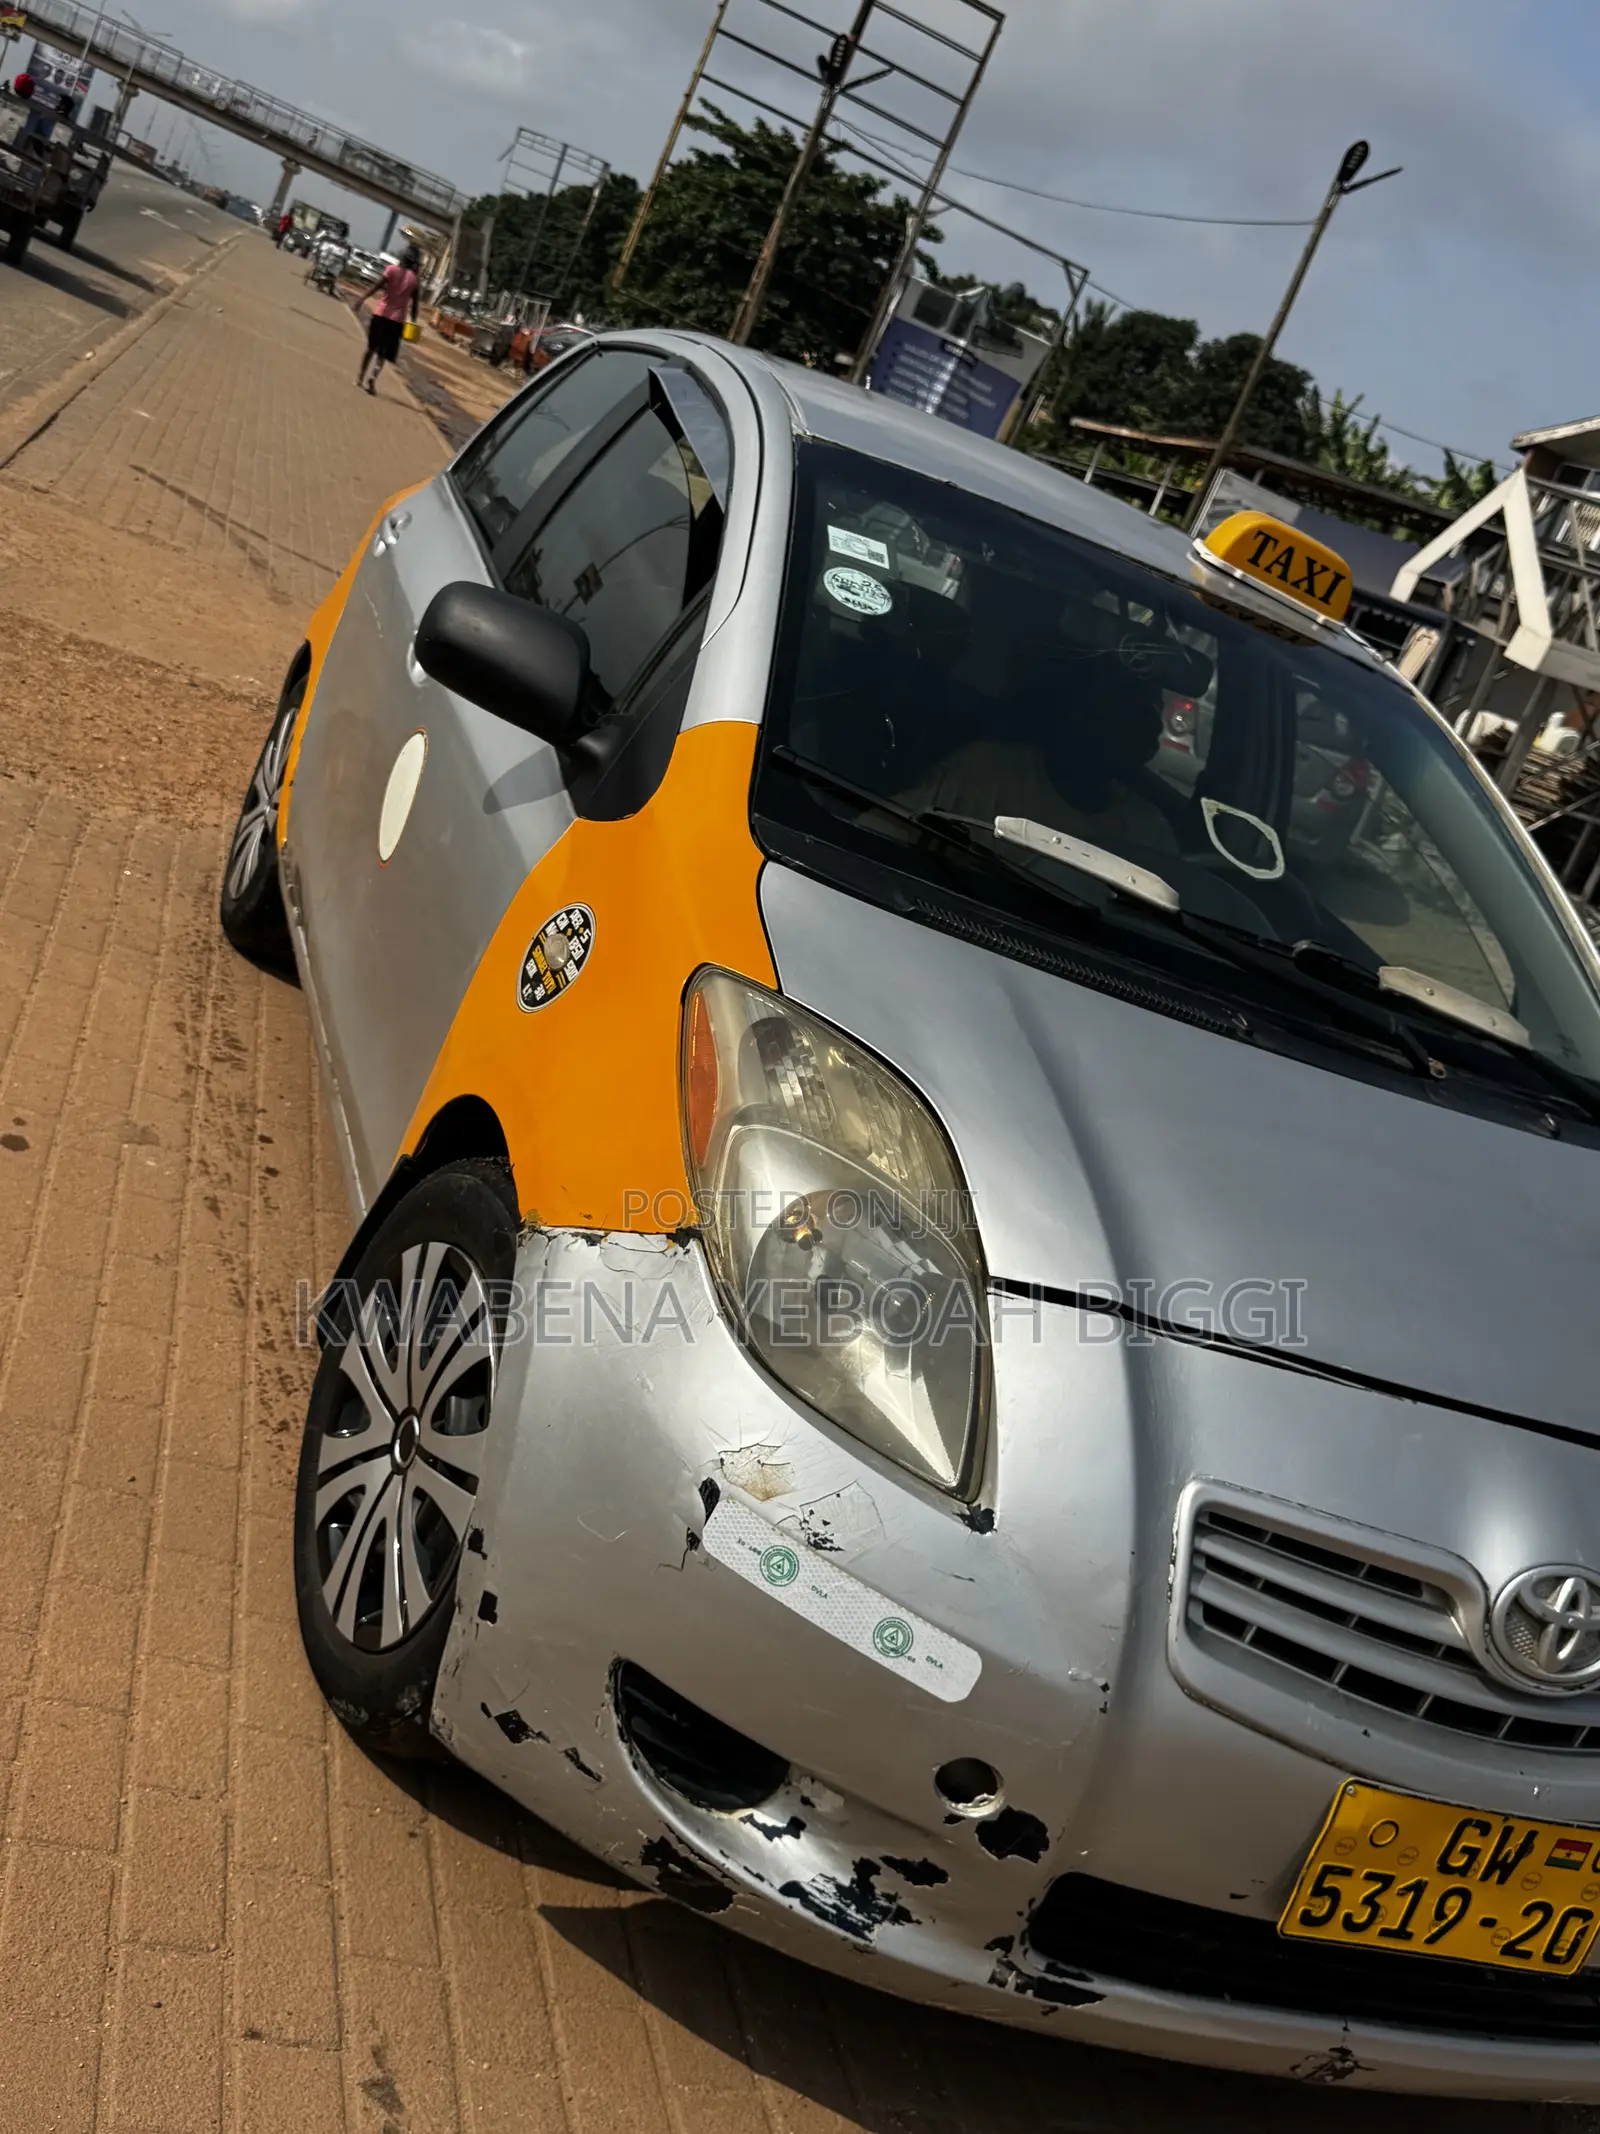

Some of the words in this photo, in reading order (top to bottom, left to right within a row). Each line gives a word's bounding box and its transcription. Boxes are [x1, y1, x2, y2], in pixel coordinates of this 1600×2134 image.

[1247, 530, 1346, 605] TAXI
[1436, 1817, 1539, 1885] GW
[1298, 1862, 1595, 1964] 5319-20
